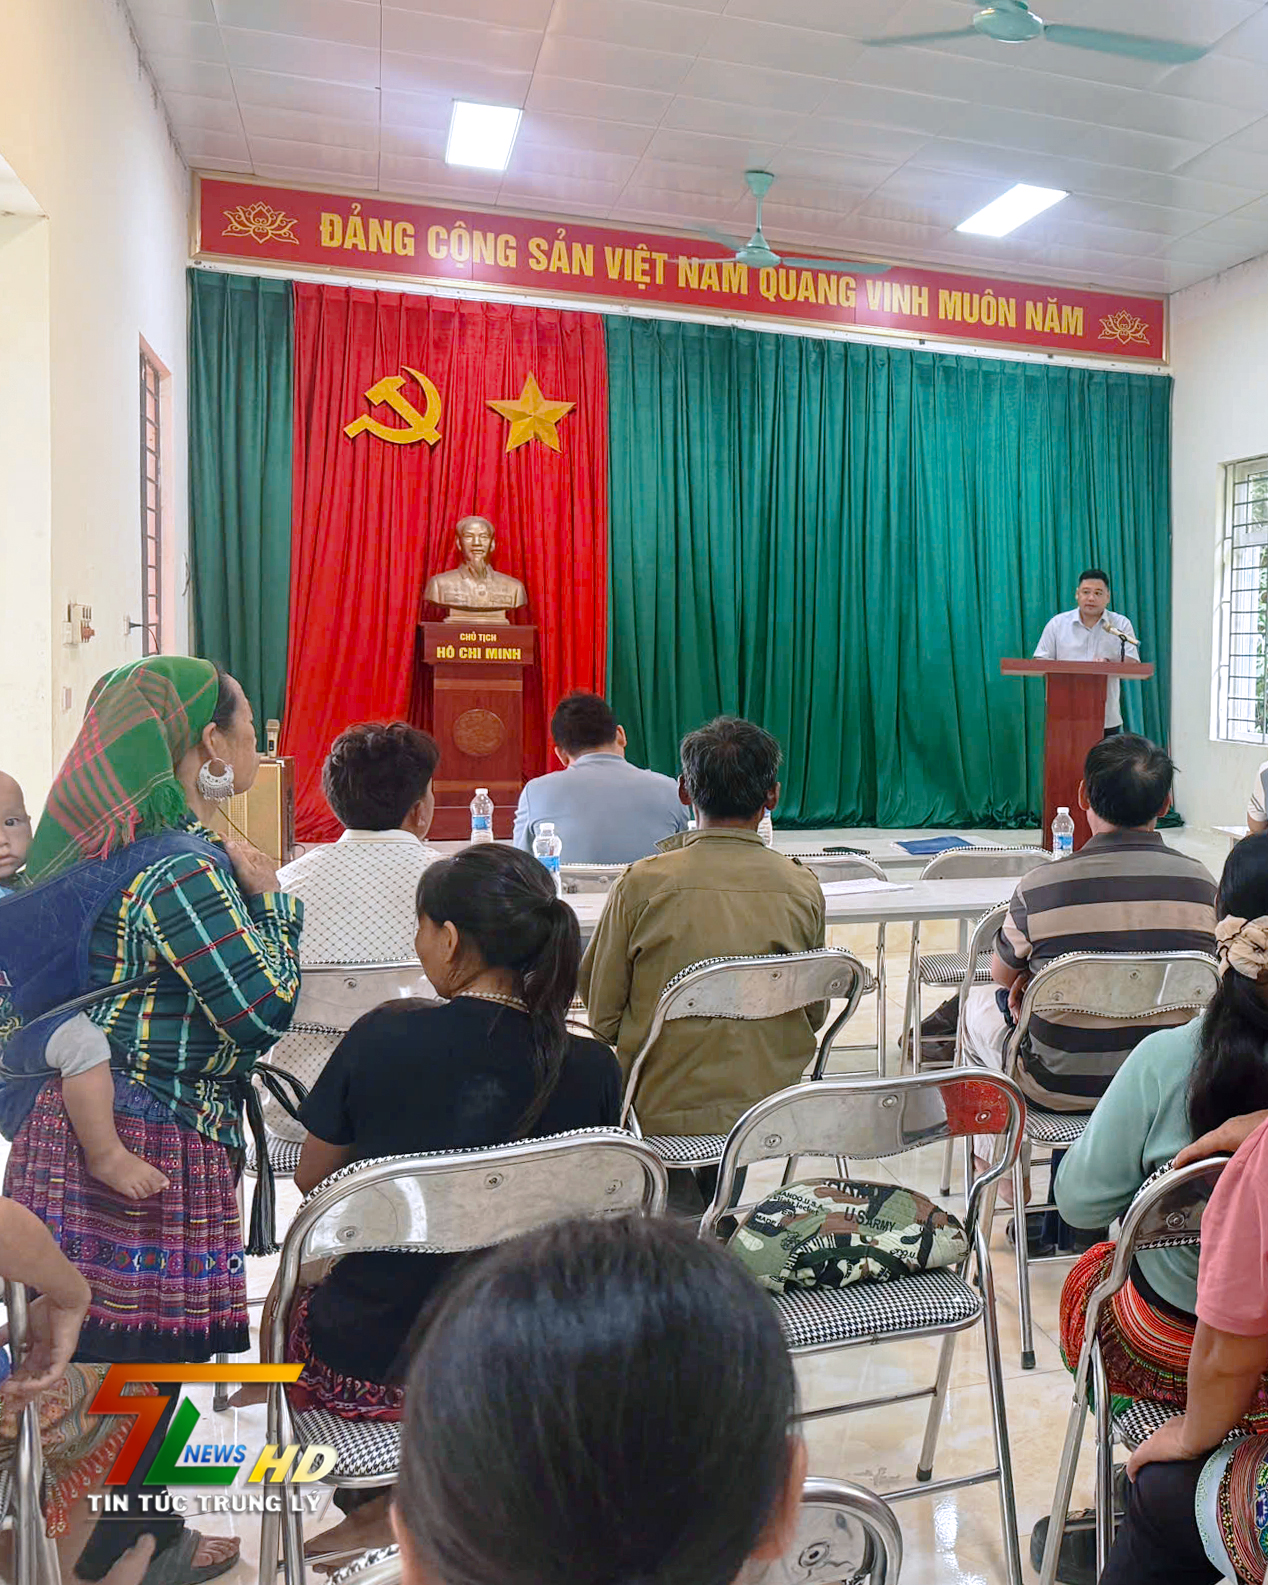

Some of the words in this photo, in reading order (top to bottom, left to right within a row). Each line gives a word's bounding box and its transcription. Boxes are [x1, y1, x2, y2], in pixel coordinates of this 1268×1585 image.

[319, 202, 415, 257] ĐẢNG
[427, 221, 517, 268] CỘNG
[528, 227, 594, 275] SẢN
[603, 243, 669, 290] VIỆT
[678, 255, 748, 295] NAM
[759, 266, 857, 309] QUANG
[866, 279, 929, 318] VINH
[937, 288, 1017, 329] MUÔN
[1025, 294, 1084, 337] NĂM
[459, 631, 477, 641] CHỦ
[478, 633, 497, 643] TỊCH
[459, 647, 482, 659] CHI
[485, 648, 521, 660] MINH
